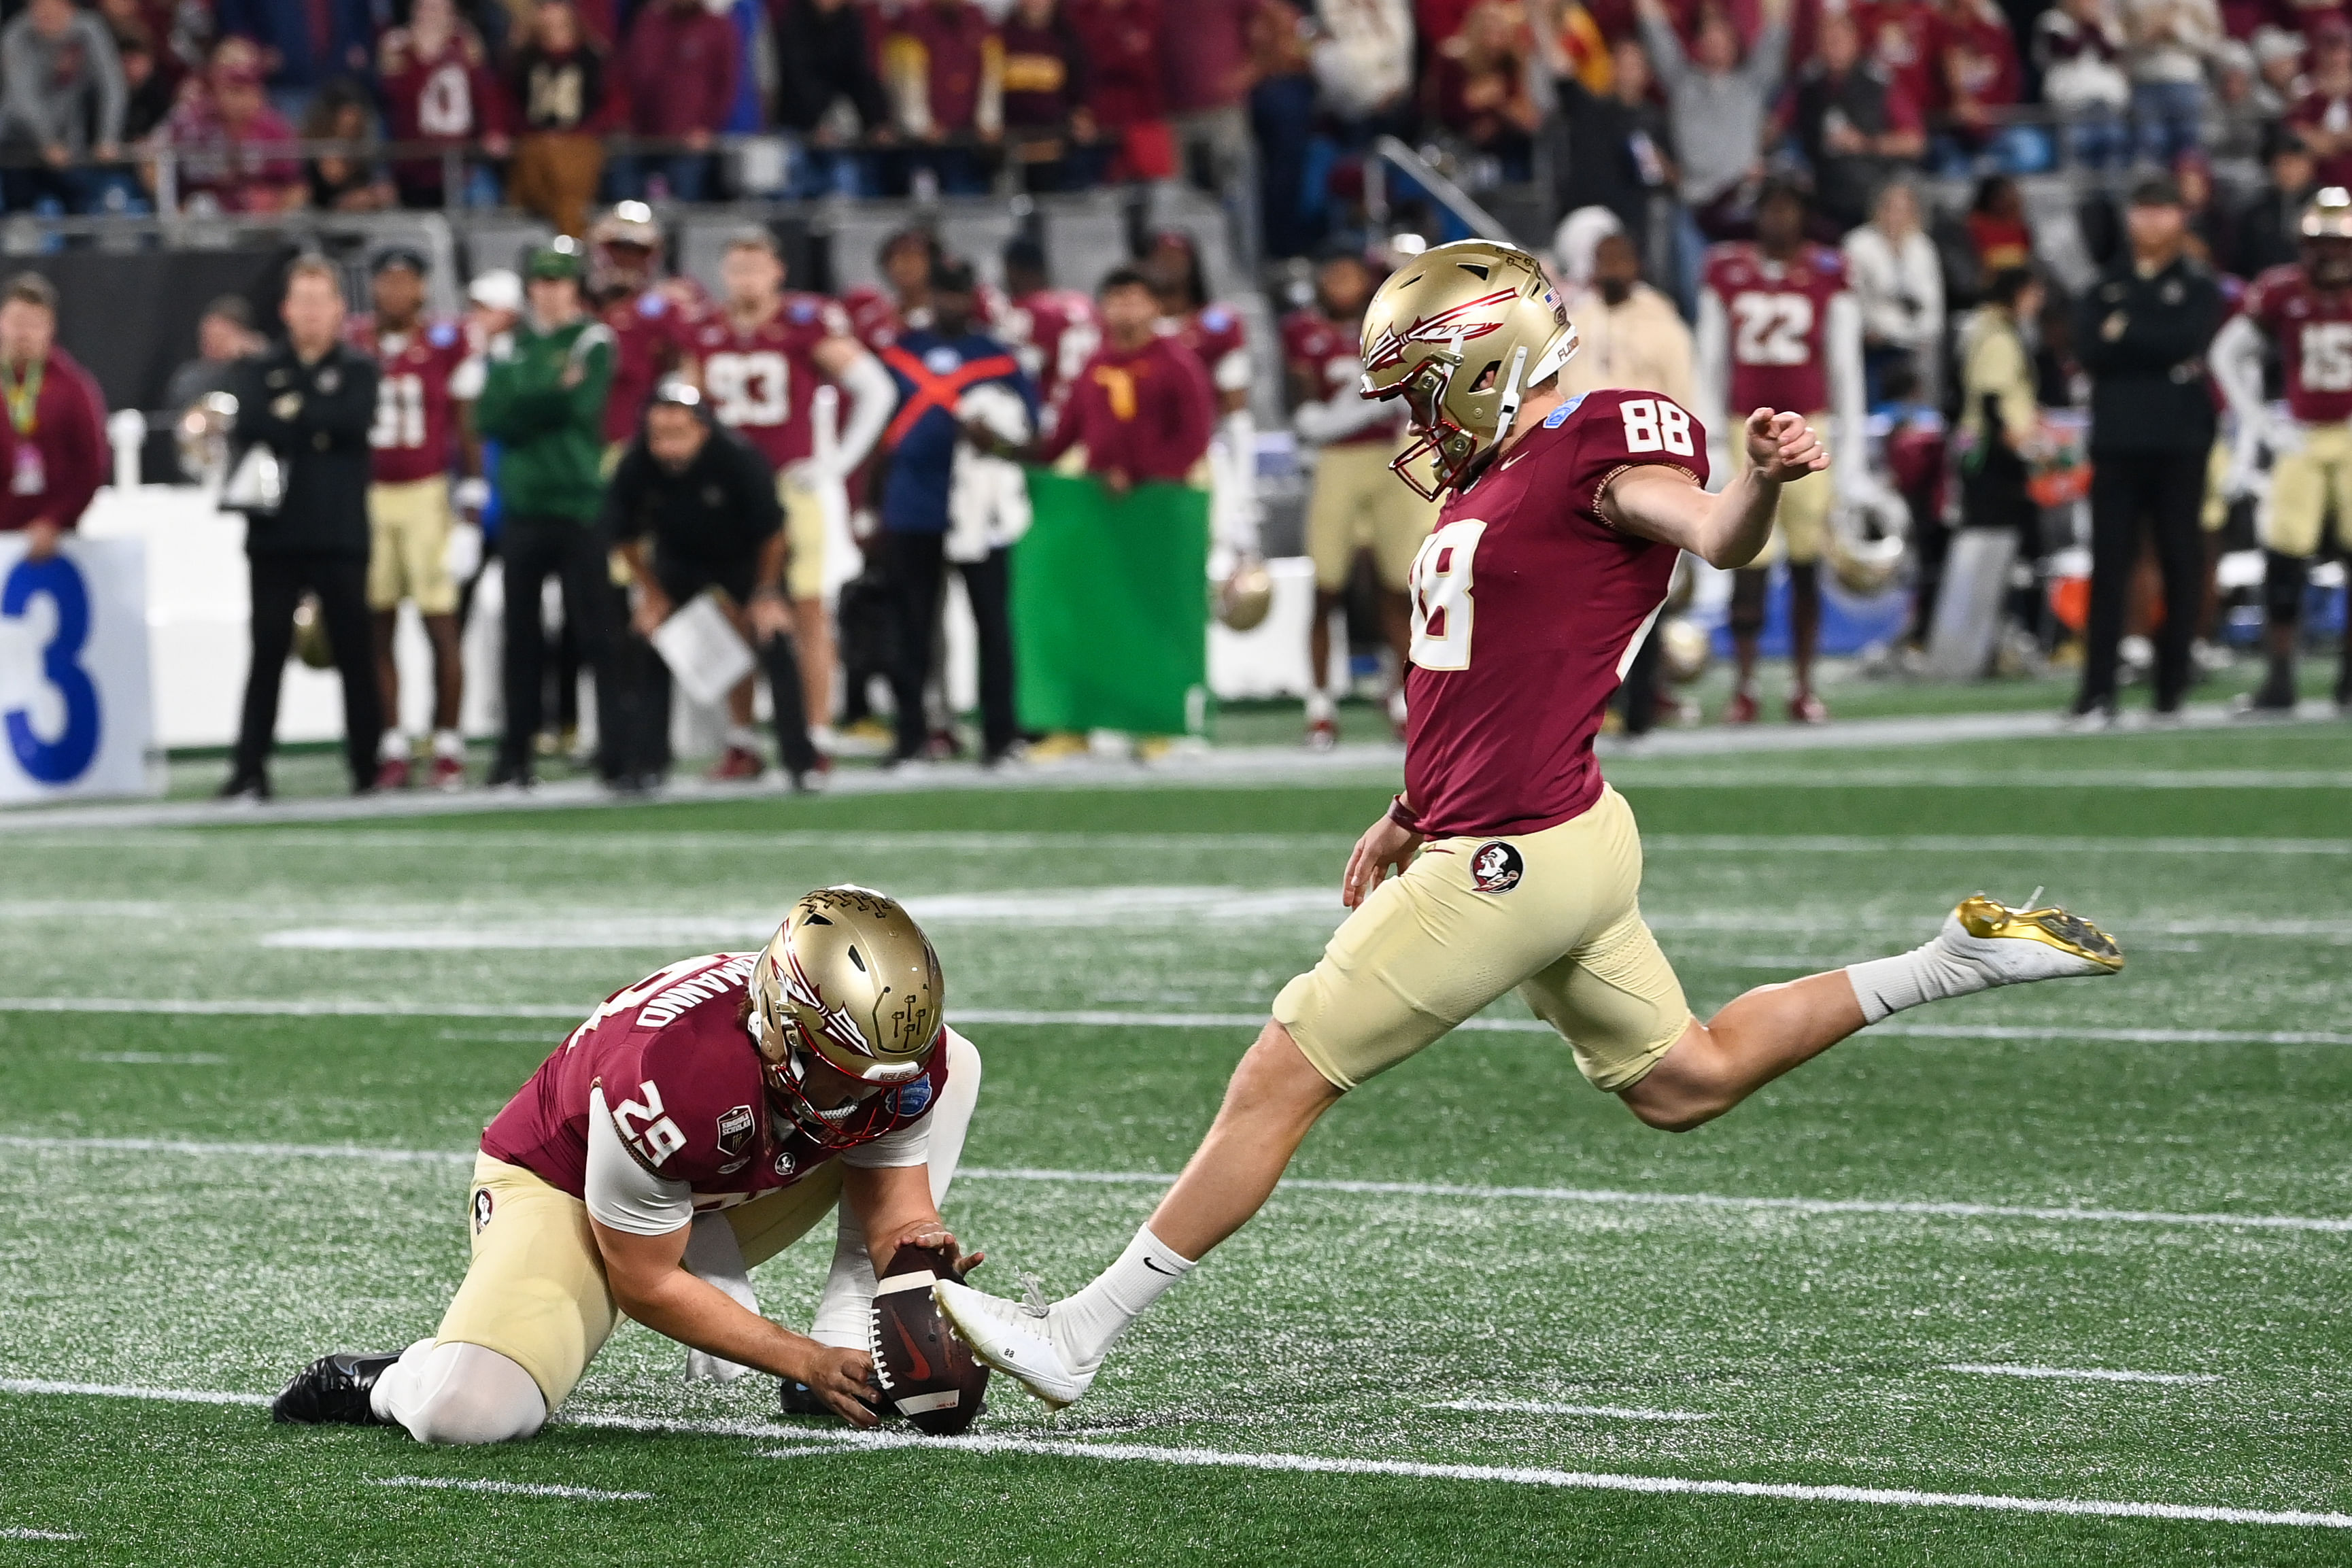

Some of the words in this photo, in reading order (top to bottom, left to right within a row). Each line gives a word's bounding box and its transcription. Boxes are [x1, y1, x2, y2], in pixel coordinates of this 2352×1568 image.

[1733, 290, 1813, 364] 22
[2300, 322, 2352, 391] 15
[706, 350, 789, 426] 93
[1618, 398, 1694, 457] 88
[1, 554, 102, 783] 3
[612, 1080, 687, 1168] 29
[1004, 1348, 1015, 1358] 88
